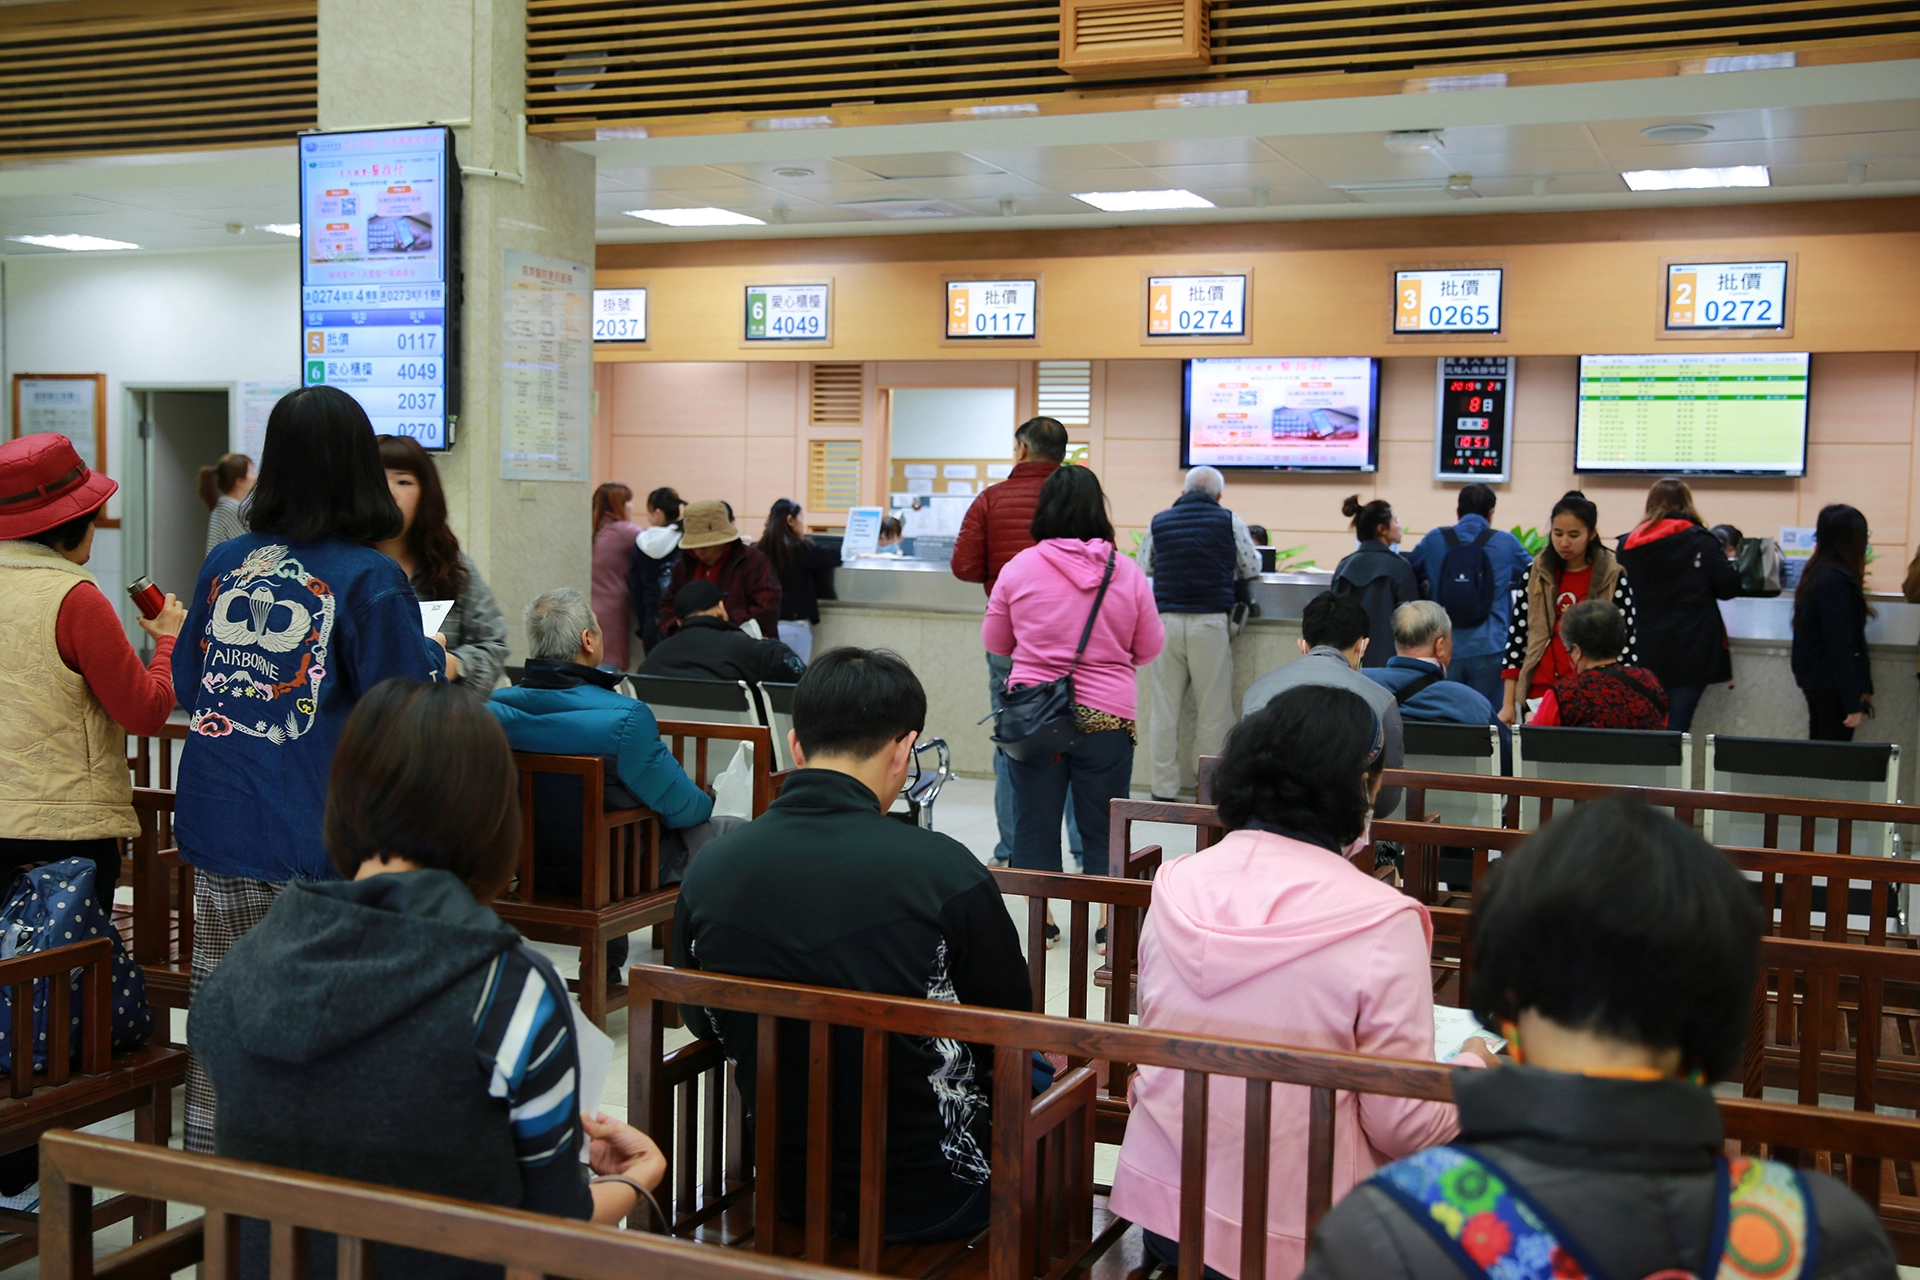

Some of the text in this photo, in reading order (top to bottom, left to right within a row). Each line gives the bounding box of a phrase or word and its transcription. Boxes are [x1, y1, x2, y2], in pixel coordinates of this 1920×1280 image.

[1440, 280, 1479, 297] 批價
[1717, 273, 1762, 291] 批價
[985, 290, 1018, 305] 批價
[1189, 286, 1225, 302] 批價
[1402, 289, 1417, 310] 3
[1675, 283, 1692, 305] 2
[603, 298, 631, 312] 掛號
[752, 302, 764, 320] 6
[953, 298, 966, 317] 5
[1154, 294, 1168, 314] 4
[1705, 300, 1772, 321] 0272
[976, 314, 1026, 331] 0117
[1179, 310, 1234, 330] 0274
[1429, 306, 1489, 326] 0265
[596, 319, 638, 336] 2037
[772, 316, 819, 334] 4049
[312, 334, 320, 350] 5
[327, 333, 350, 346] 批價
[398, 333, 437, 350] 0117
[312, 365, 321, 380] 6
[398, 363, 436, 380] 4049
[398, 393, 436, 410] 2037
[398, 423, 436, 440] 0270
[212, 648, 280, 682] AIRBORNE
